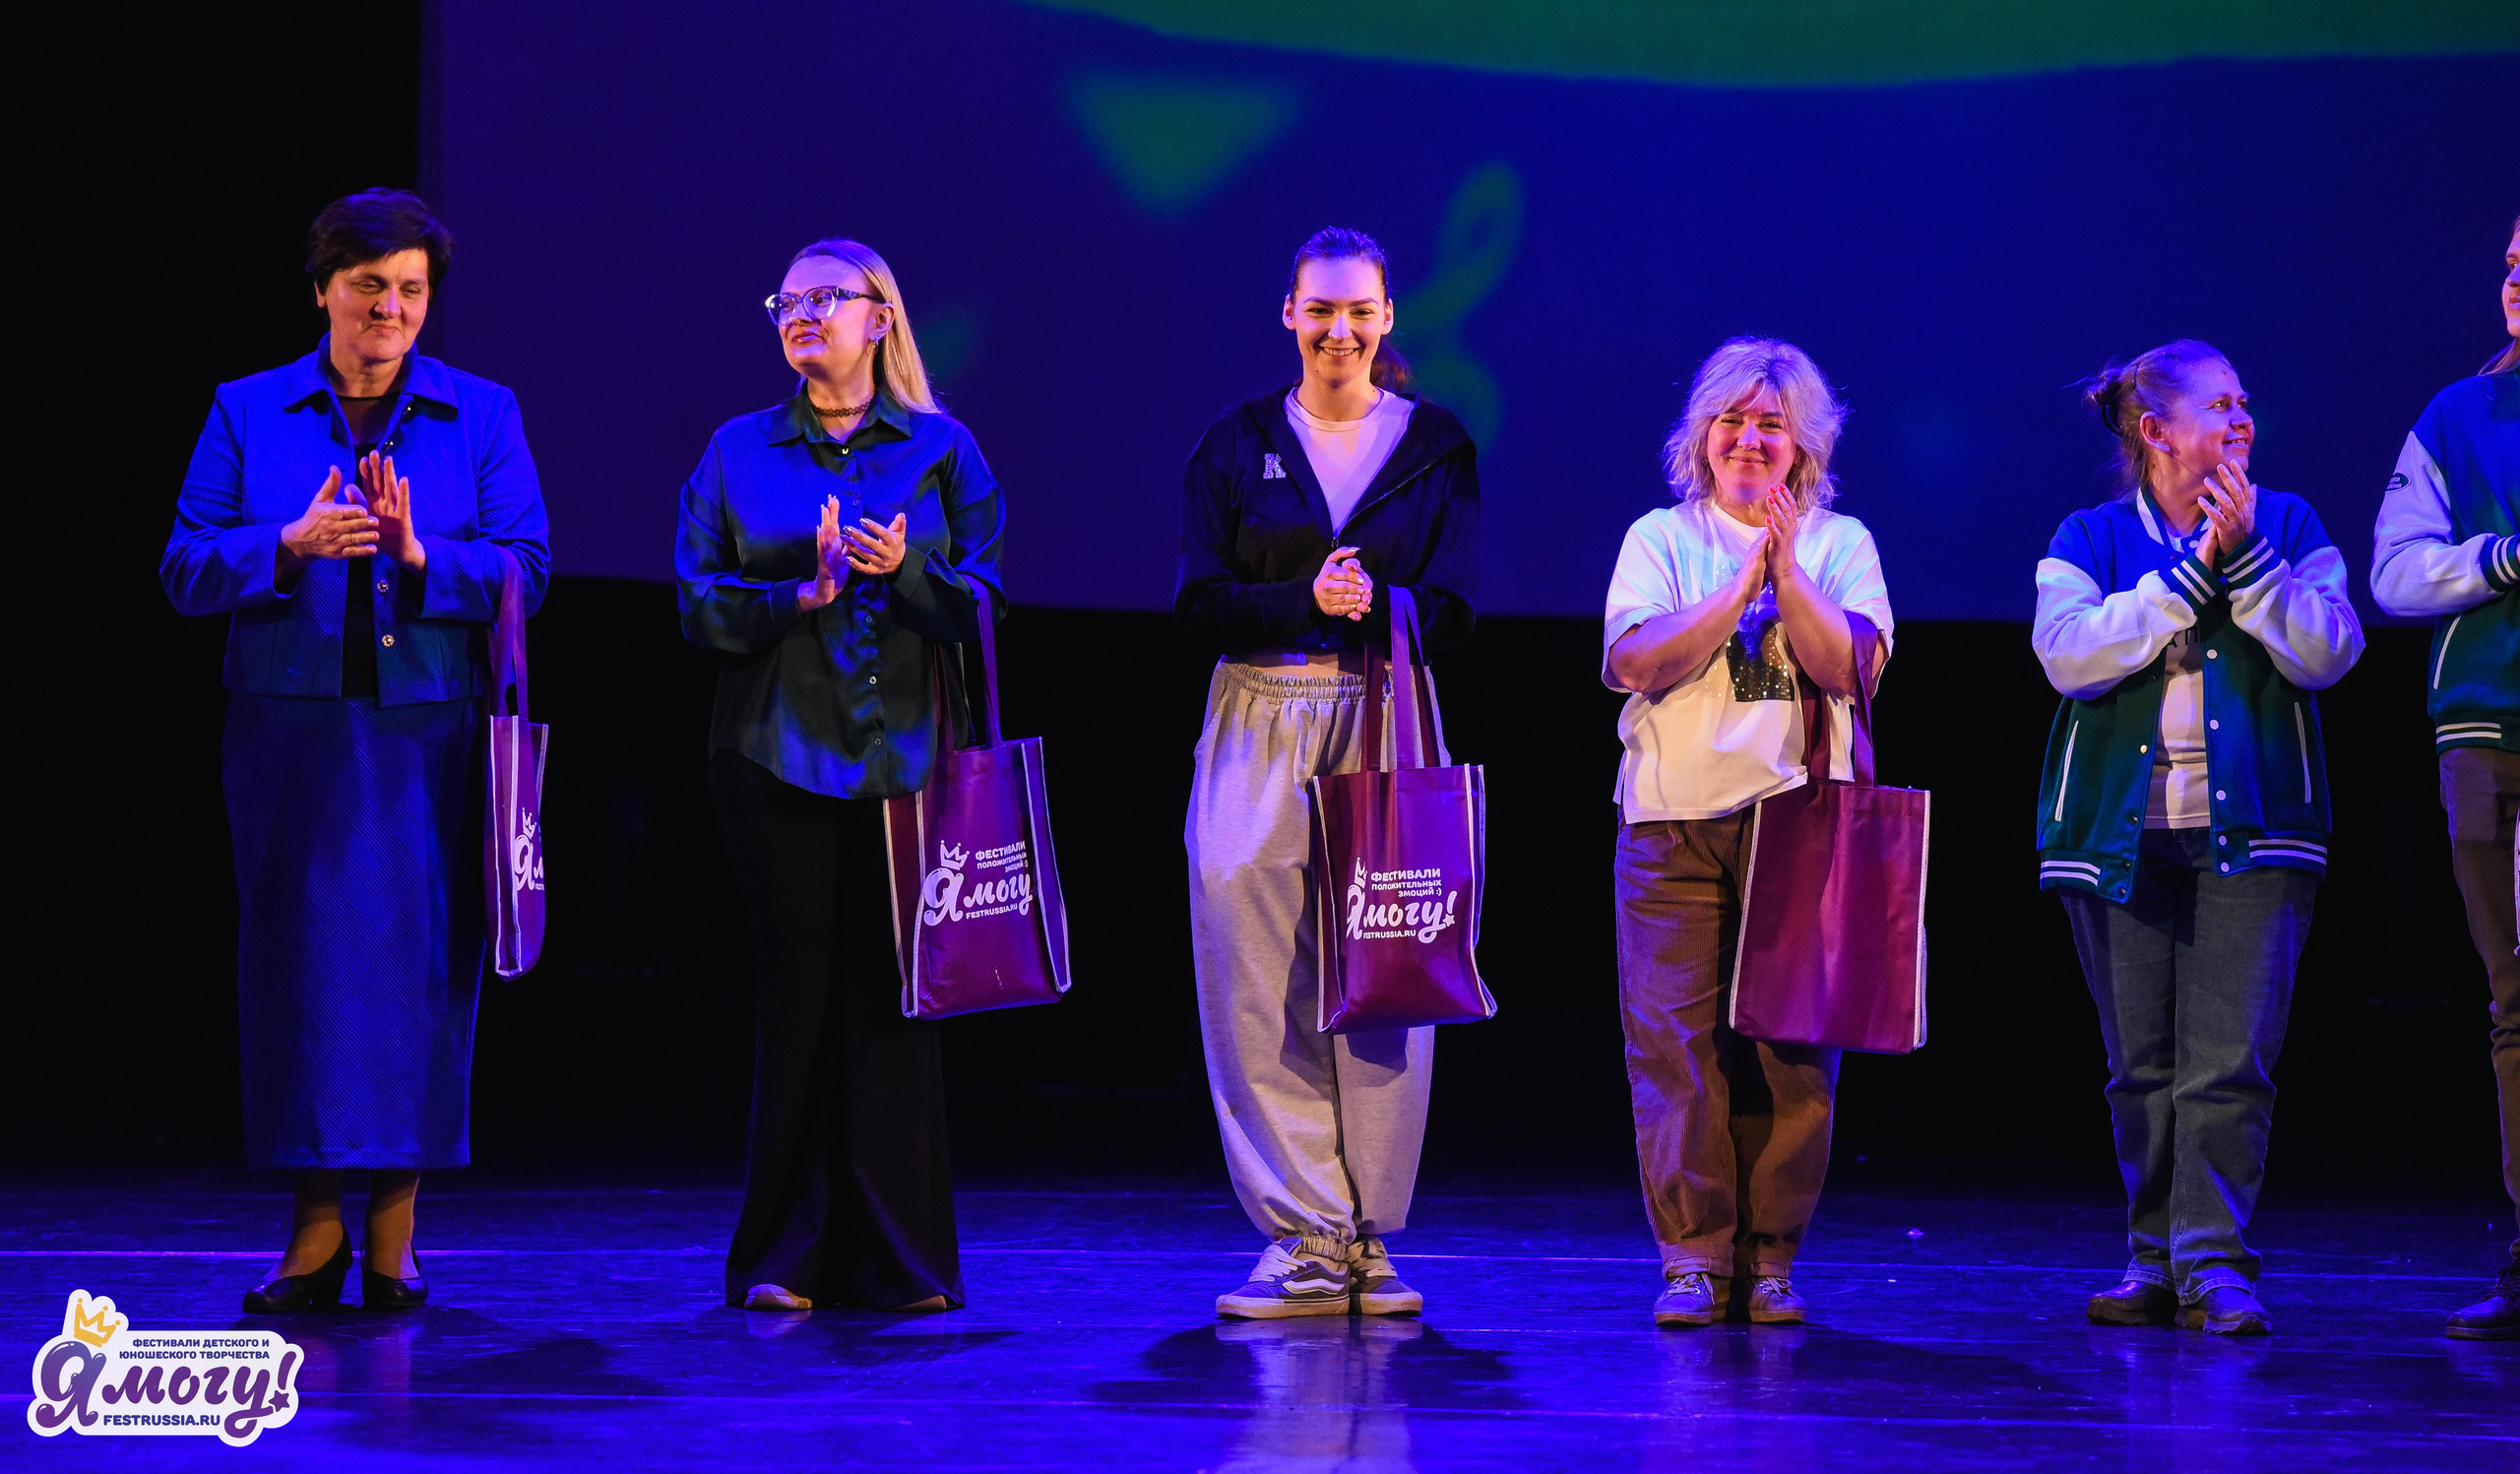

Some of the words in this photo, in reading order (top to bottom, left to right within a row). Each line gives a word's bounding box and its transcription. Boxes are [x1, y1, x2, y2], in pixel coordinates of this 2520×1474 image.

[976, 841, 1026, 861] ФЕСТИВАЛИ
[1370, 867, 1440, 882] ФЕСТИВАЛИ
[1398, 887, 1434, 897] ЭМОЦИЙ
[966, 903, 1018, 920] FESTRUSSIA.RU
